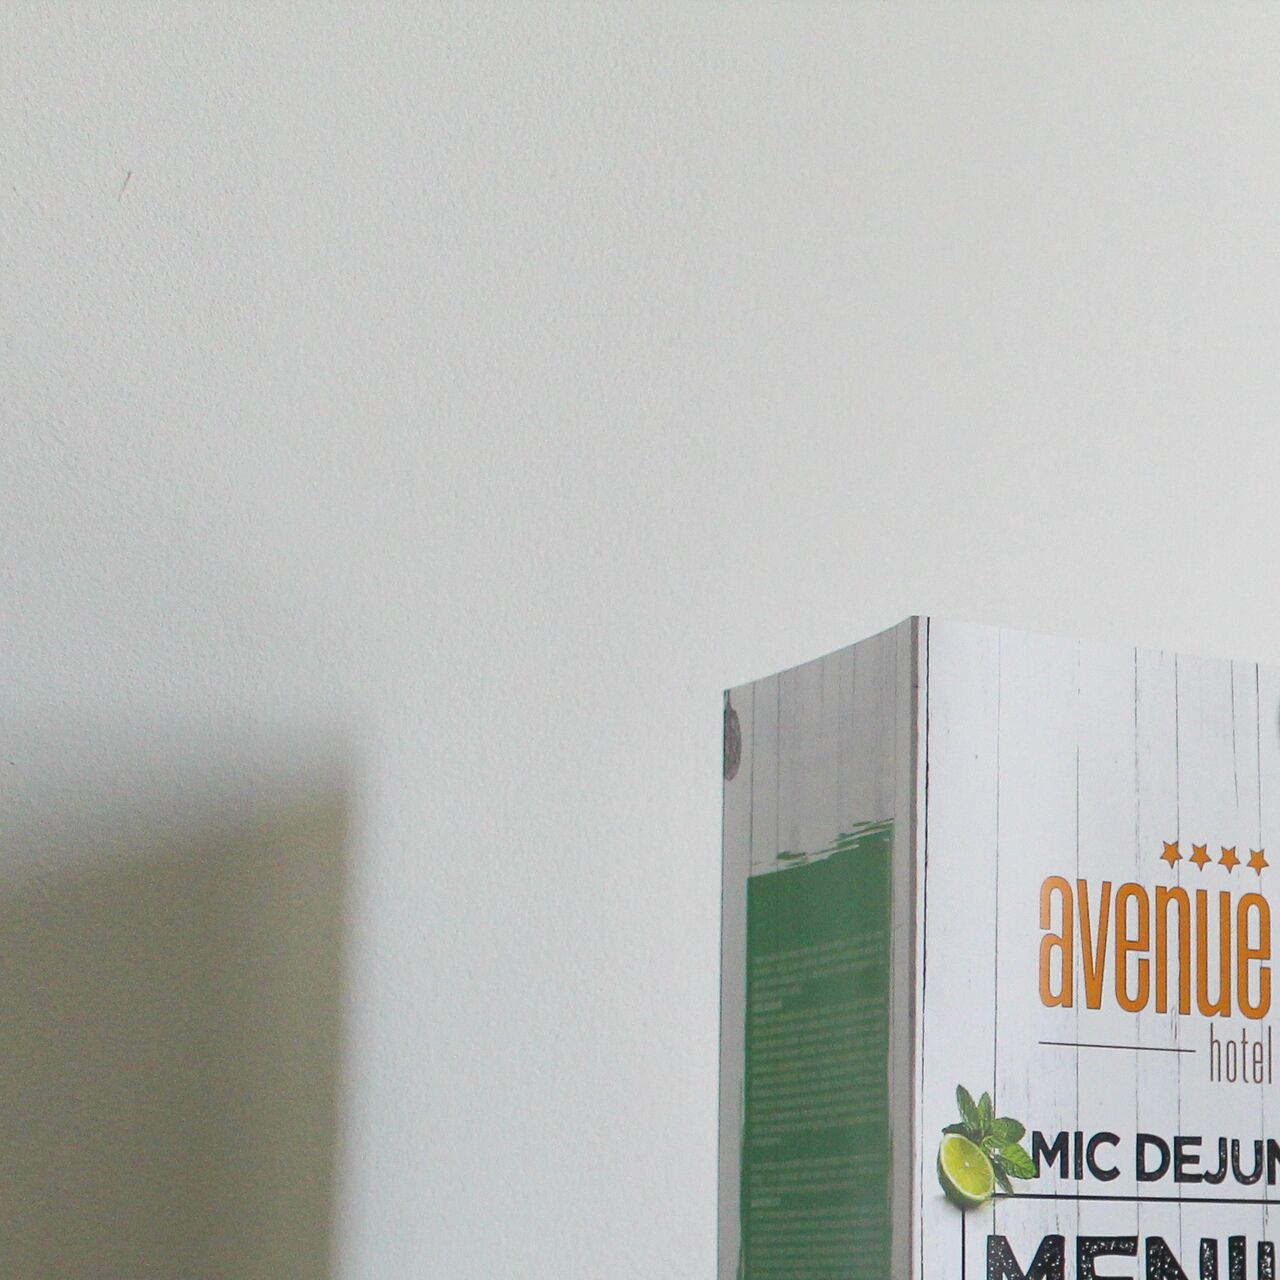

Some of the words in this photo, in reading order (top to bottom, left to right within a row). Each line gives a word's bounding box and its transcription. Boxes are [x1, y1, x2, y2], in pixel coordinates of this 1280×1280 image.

[1038, 874, 1272, 1020] avenue
[1209, 1023, 1273, 1085] hotel
[1031, 1130, 1121, 1183] MIC
